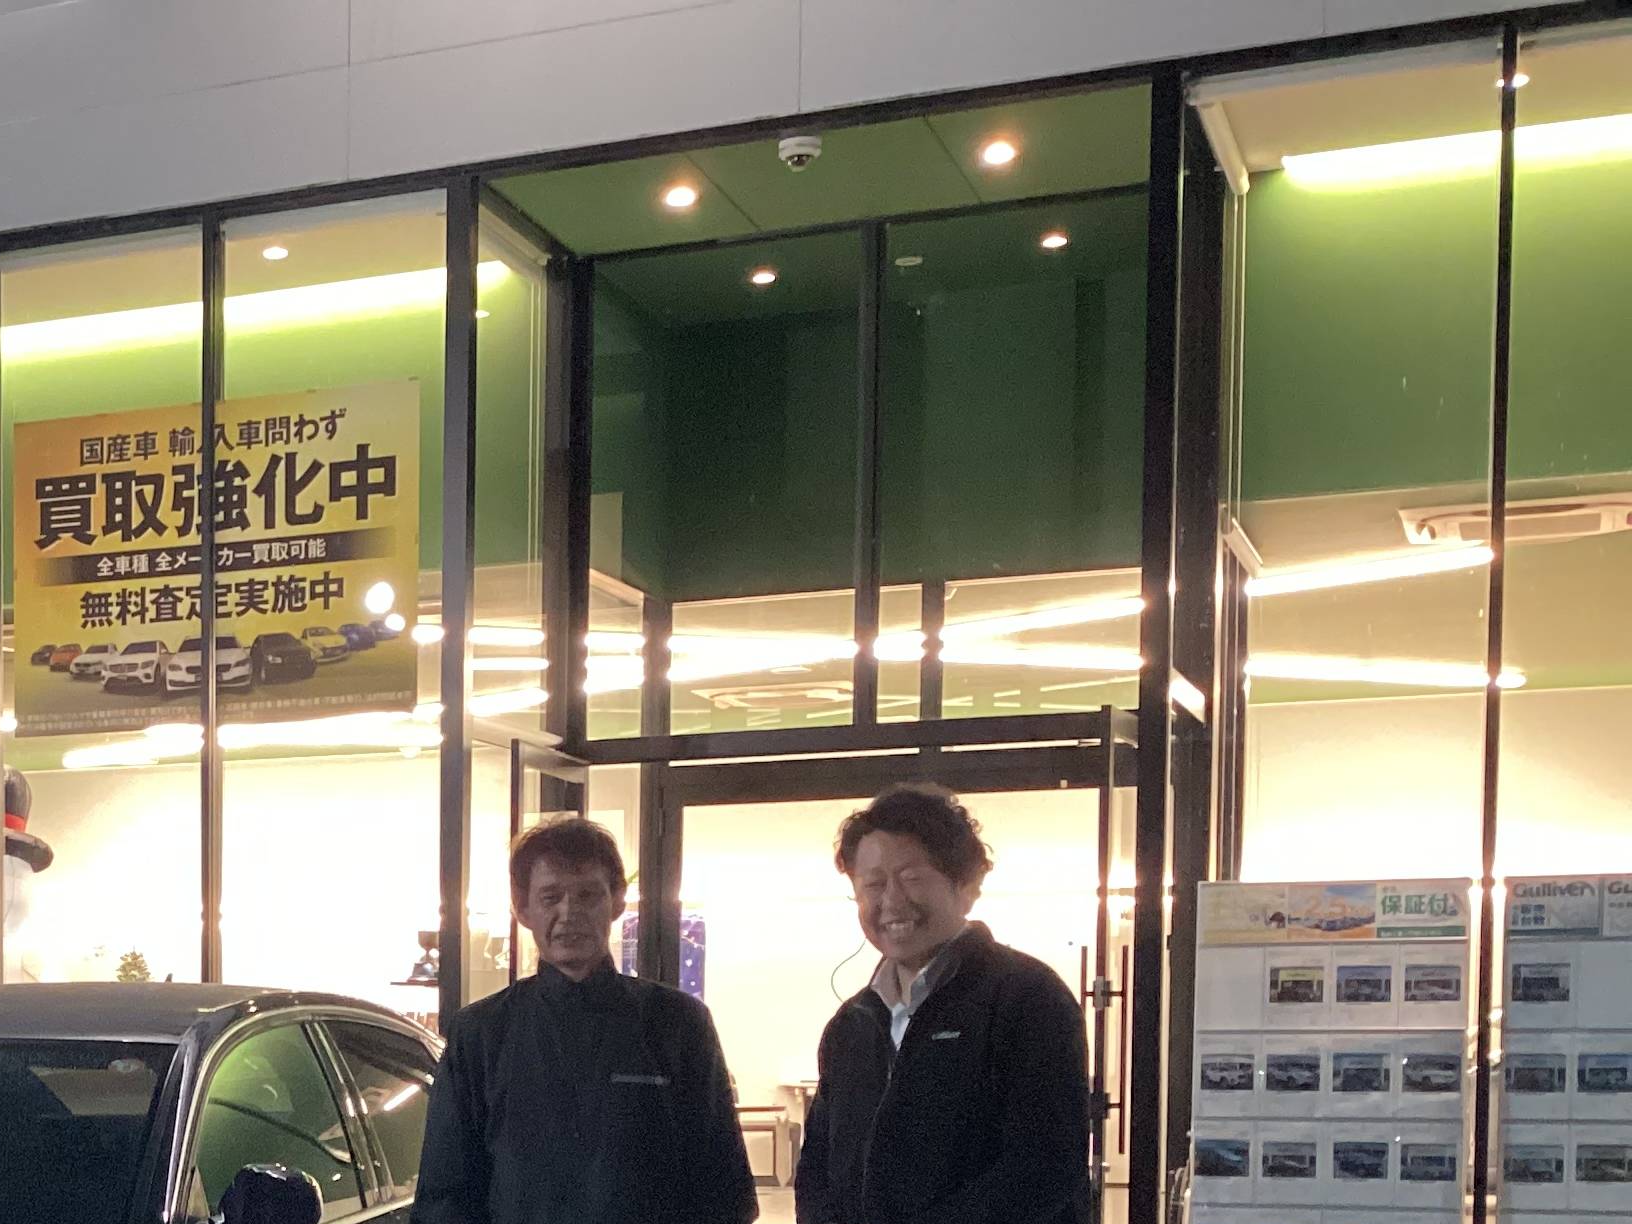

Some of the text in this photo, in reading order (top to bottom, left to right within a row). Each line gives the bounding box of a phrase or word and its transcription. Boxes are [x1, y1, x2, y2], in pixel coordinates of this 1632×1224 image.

[79, 408, 347, 467] 国産車 輸入車問わず
[34, 443, 397, 551] 買取強化中
[96, 538, 327, 577] 全車種 全メーカー買取可能
[79, 570, 345, 629] 無料査定実施中
